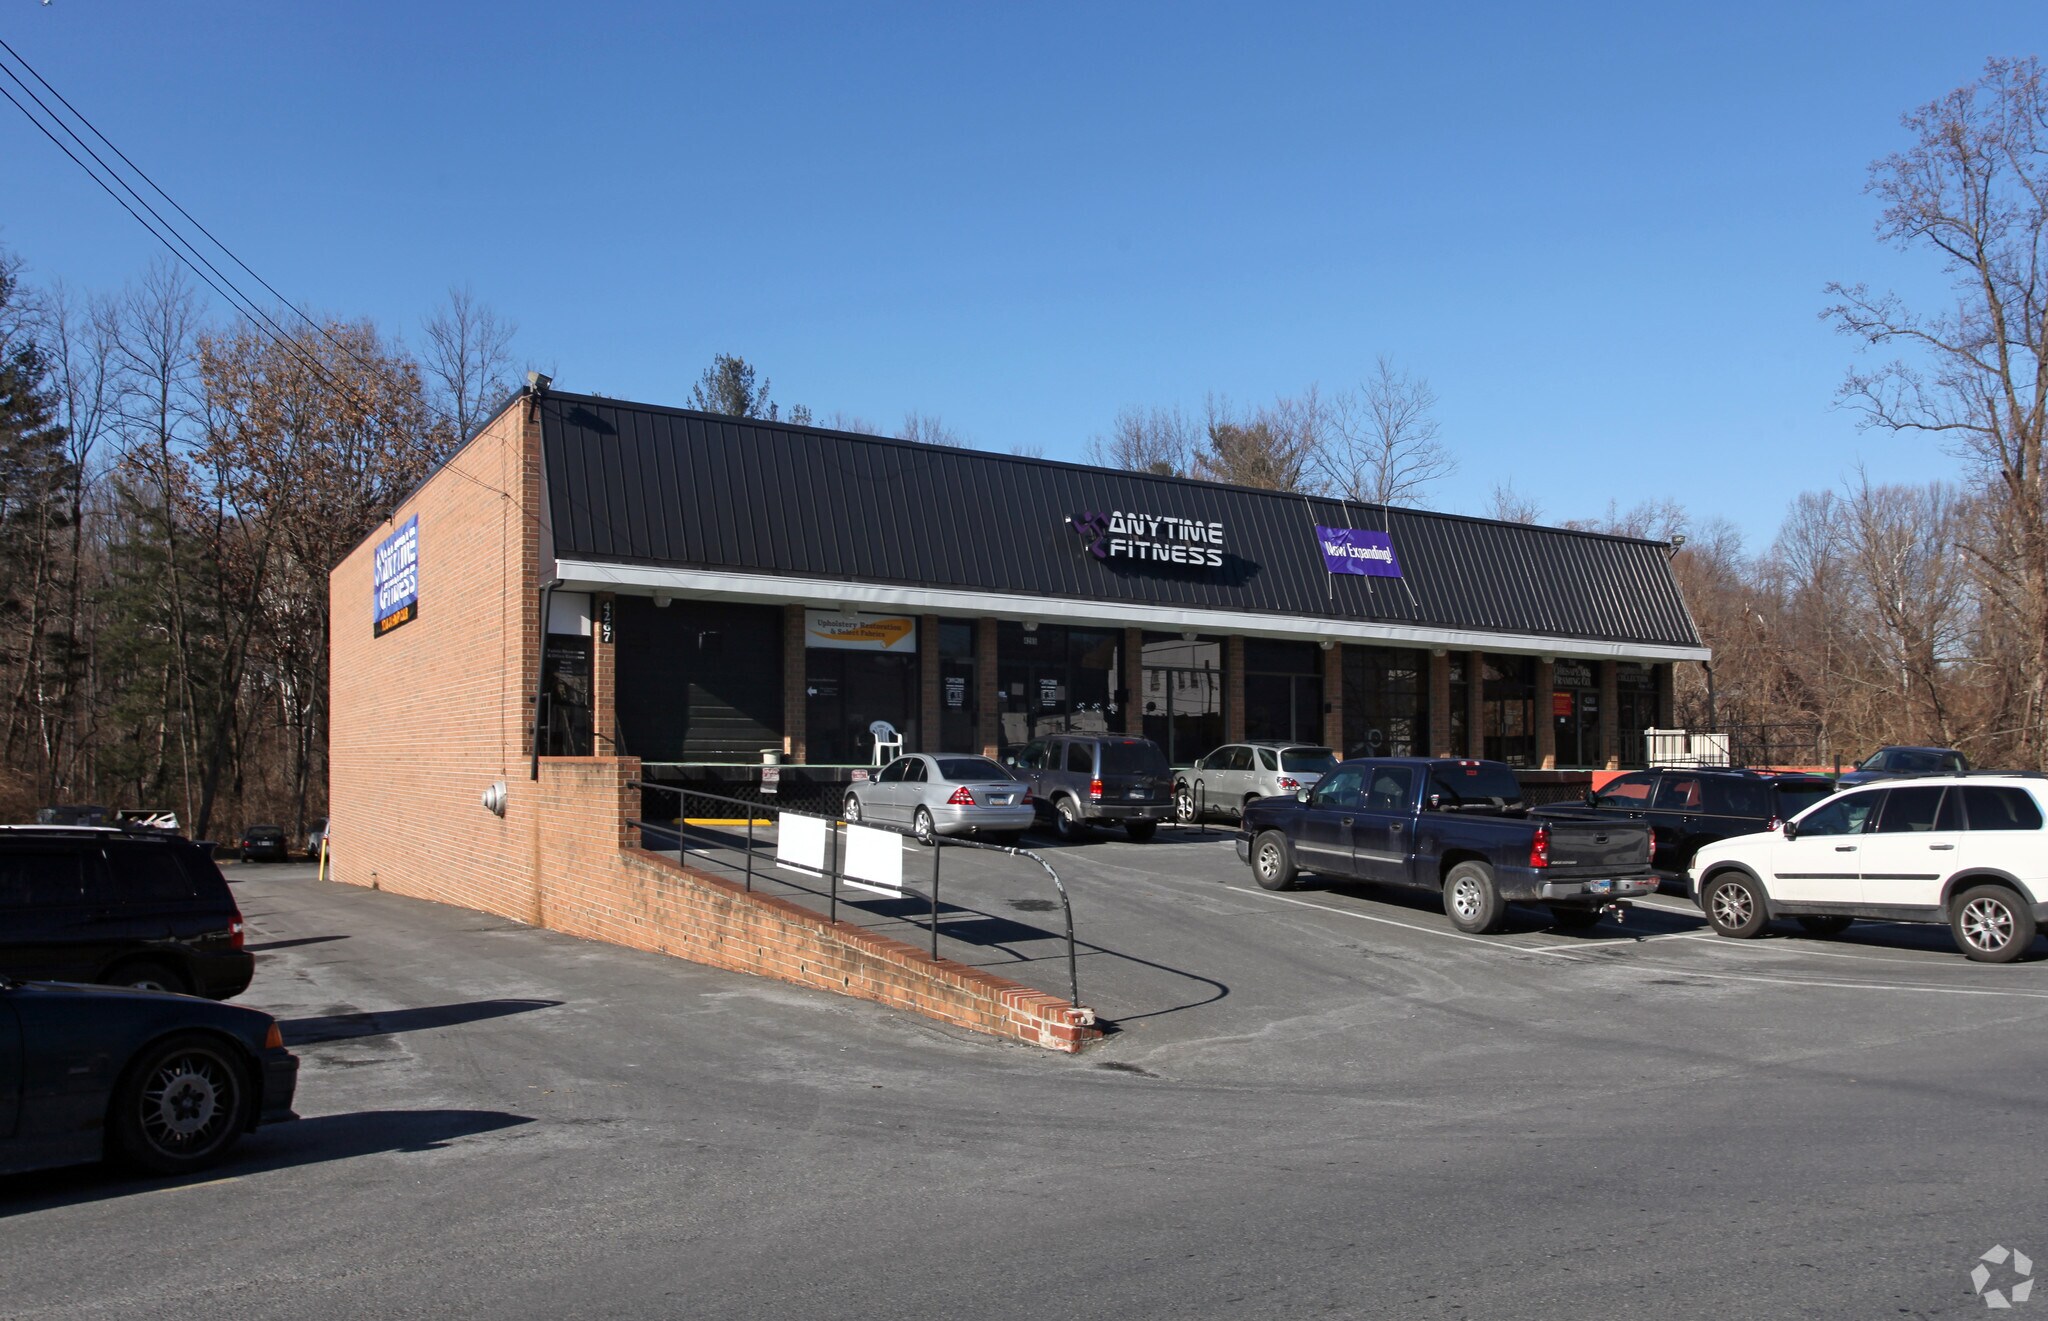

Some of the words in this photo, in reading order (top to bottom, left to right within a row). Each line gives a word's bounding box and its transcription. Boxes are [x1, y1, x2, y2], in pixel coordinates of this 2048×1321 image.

[1108, 510, 1223, 545] ANYTIME
[1110, 539, 1223, 567] FITNESS
[1324, 540, 1347, 557] Now
[1346, 542, 1393, 564] Expanding!
[603, 601, 612, 642] 4267
[817, 618, 858, 629] Upholstery
[860, 621, 903, 632] Restoration
[838, 628, 859, 637] Select
[860, 630, 886, 638] Fabrics
